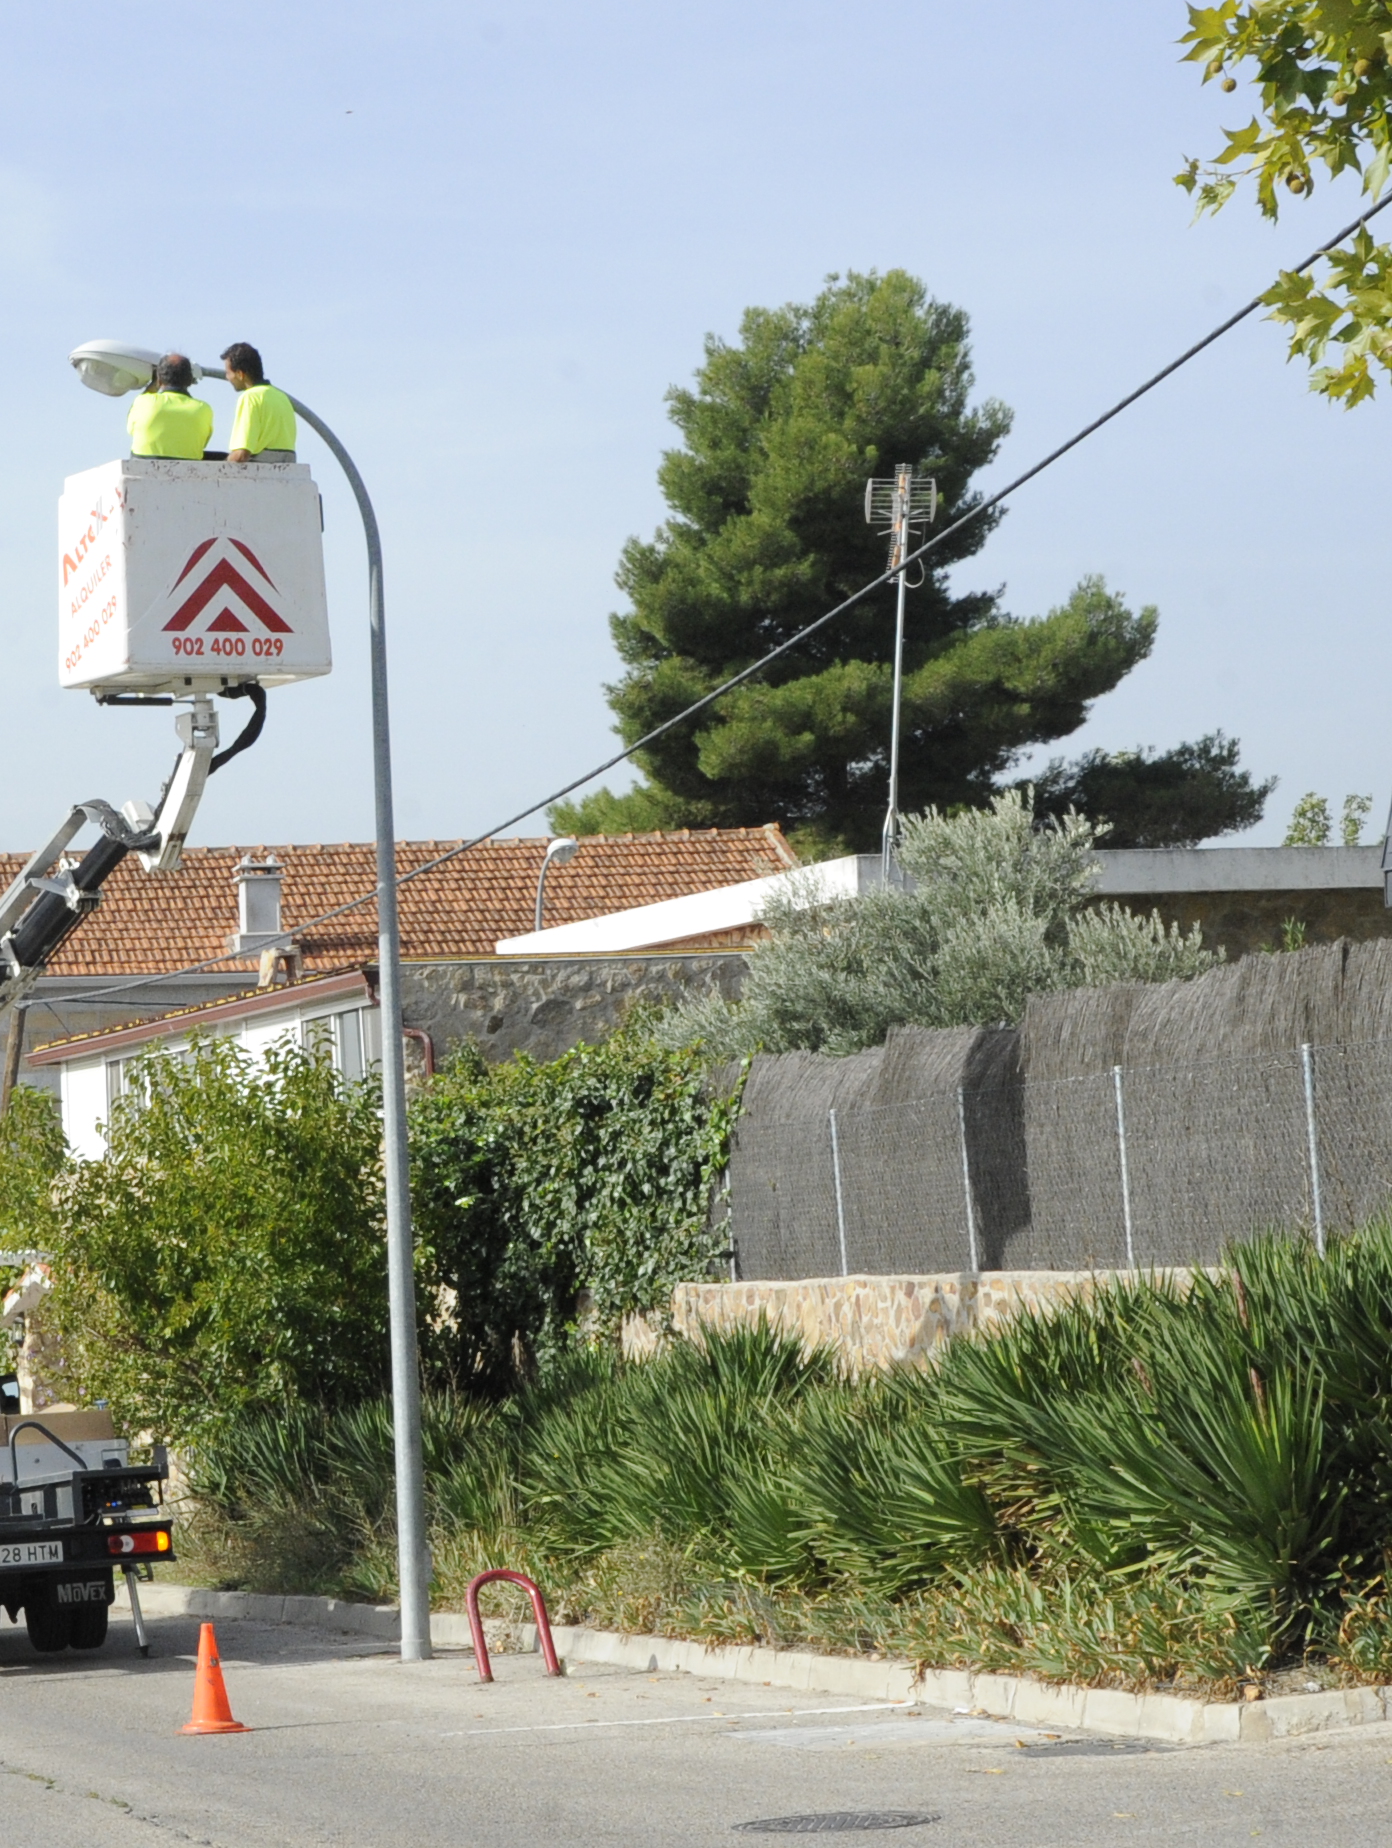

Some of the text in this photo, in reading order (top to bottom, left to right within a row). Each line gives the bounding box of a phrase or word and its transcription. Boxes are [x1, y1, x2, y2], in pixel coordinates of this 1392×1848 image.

[71, 554, 112, 618] ALQUILER
[66, 595, 117, 674] 902 400 029
[172, 636, 284, 656] 902 400 029
[27, 1544, 59, 1562] HTM
